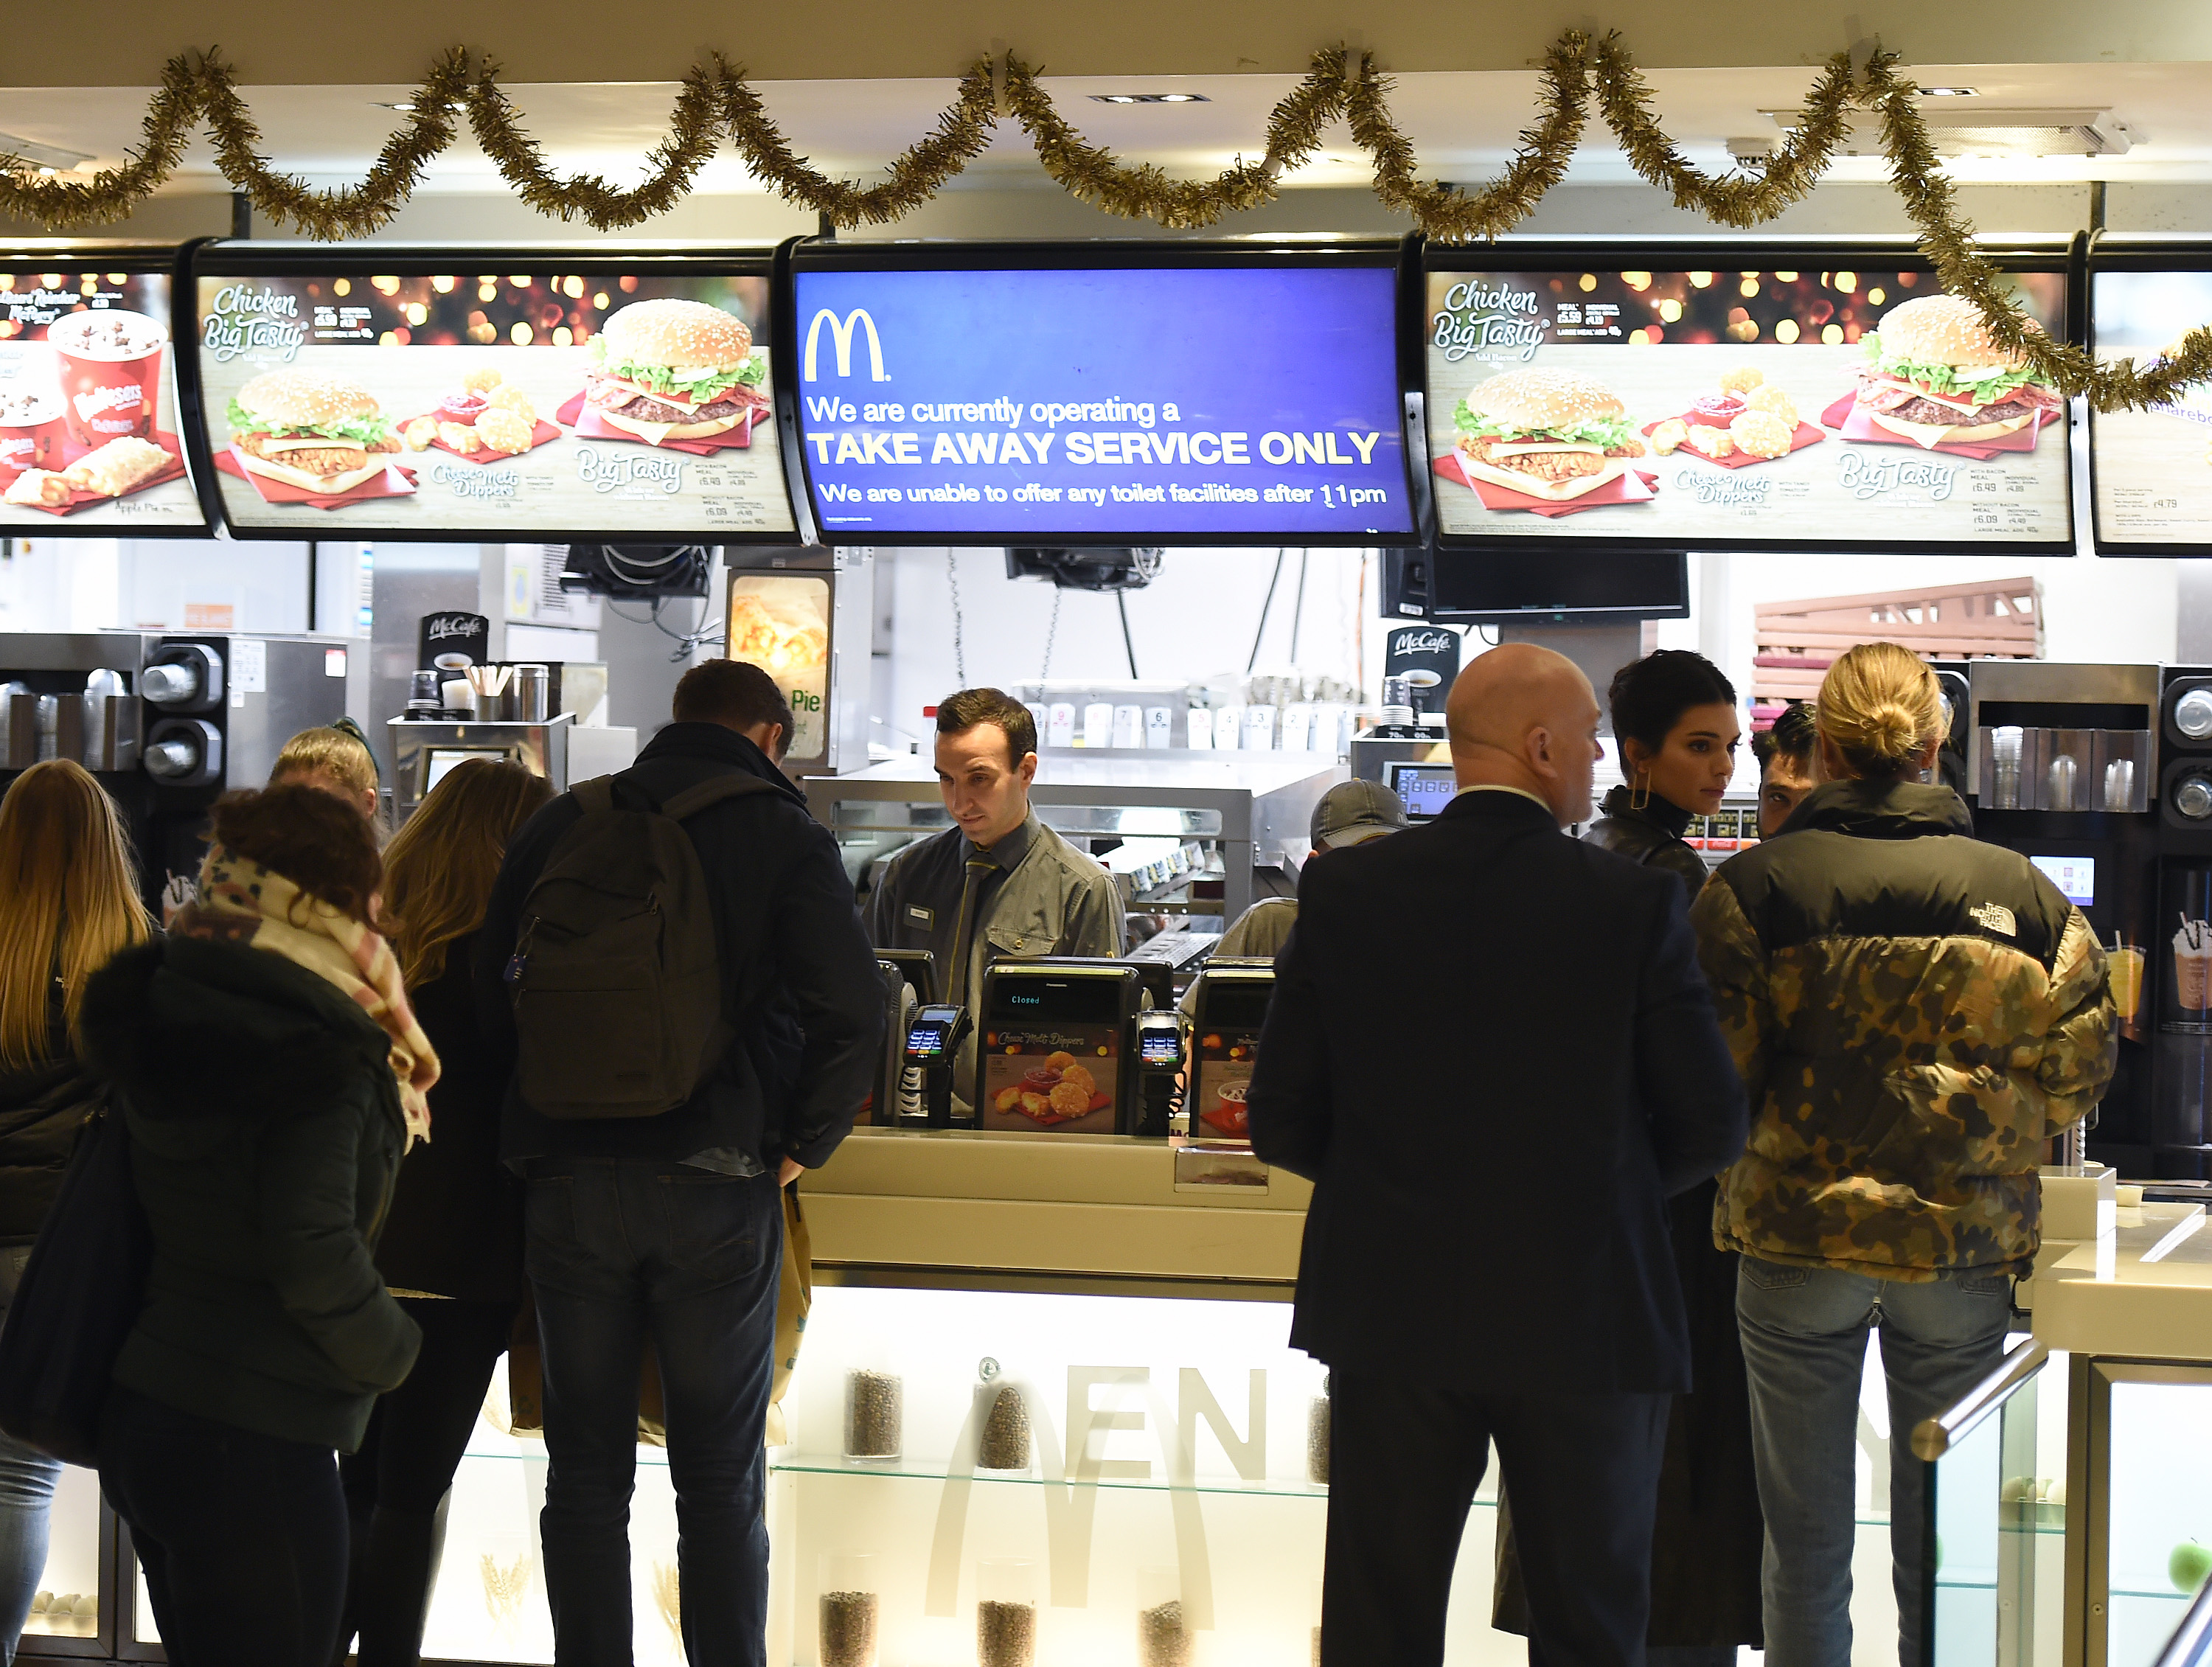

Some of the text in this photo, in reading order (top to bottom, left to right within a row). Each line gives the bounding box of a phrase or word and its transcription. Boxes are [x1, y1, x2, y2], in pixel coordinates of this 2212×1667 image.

[213, 284, 299, 319] Chicken
[1444, 279, 1539, 316] Chicken
[204, 313, 305, 363] Big Tasty
[1433, 311, 1545, 361] Big Tasty
[806, 395, 1181, 428] We are currently operating a
[807, 431, 1380, 465] TAKE AWAY SERVICE ONLY
[431, 463, 479, 484] Cheese
[477, 469, 518, 486] Melt
[574, 445, 683, 494] Big Tasty
[1674, 467, 1771, 492] Cheese Melt
[1837, 449, 1955, 501] Big Tasty
[452, 479, 515, 501] Dippers
[700, 477, 721, 486] £6.49
[1972, 483, 1997, 492] £6.49
[818, 482, 1387, 508] We are unable to offer any toilet facilities after 11pm
[1695, 483, 1764, 507] Dippers
[2154, 499, 2177, 509] £4.79
[1974, 515, 1997, 524] £6.09
[428, 616, 481, 641] McCafé
[1394, 630, 1451, 656] McCafé
[791, 689, 820, 711] Pie
[1155, 712, 1163, 722] 6
[1198, 714, 1205, 723] 5
[1258, 713, 1265, 723] 3
[1969, 907, 2003, 922] NORTH
[1985, 902, 2003, 914] THE
[1980, 917, 2003, 931] FACE
[1012, 996, 1040, 1004] Closed
[1023, 1033, 1048, 1044] Melt
[1049, 1032, 1085, 1048] Dippers
